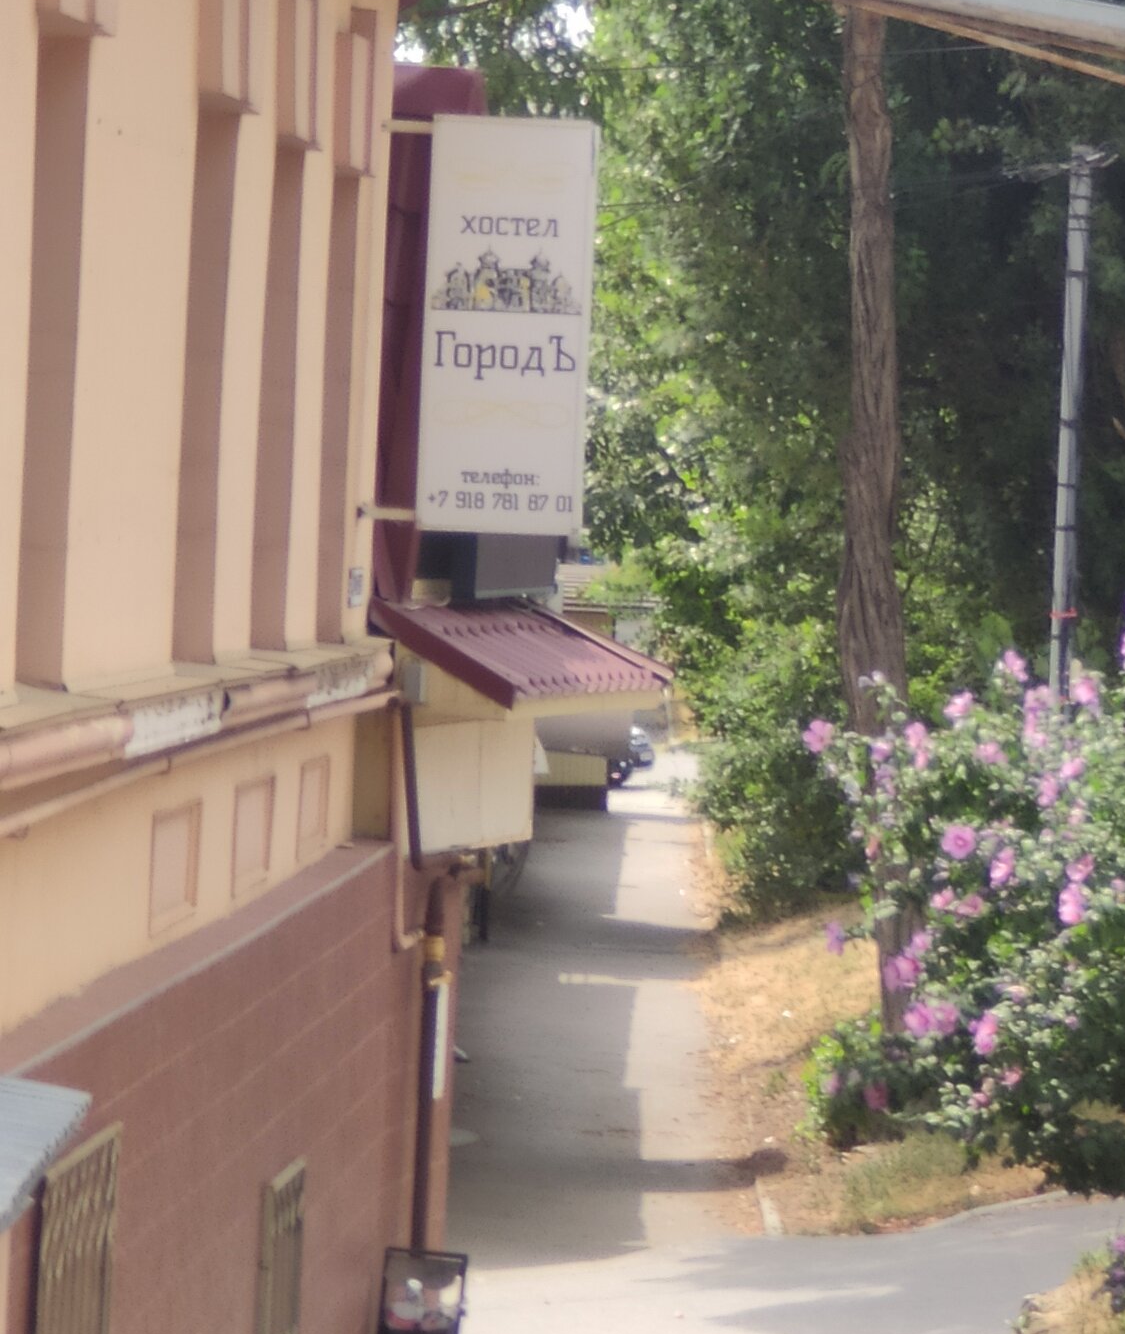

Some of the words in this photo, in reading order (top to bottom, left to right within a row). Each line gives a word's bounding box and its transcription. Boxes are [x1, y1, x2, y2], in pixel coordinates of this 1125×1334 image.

[461, 215, 559, 237] хостел
[434, 331, 576, 380] ГородЪ
[461, 469, 541, 489] телефон:
[428, 490, 449, 508] +7
[455, 491, 485, 509] 918
[493, 493, 519, 511] 781
[528, 494, 549, 512] 87
[556, 495, 573, 512] 01
